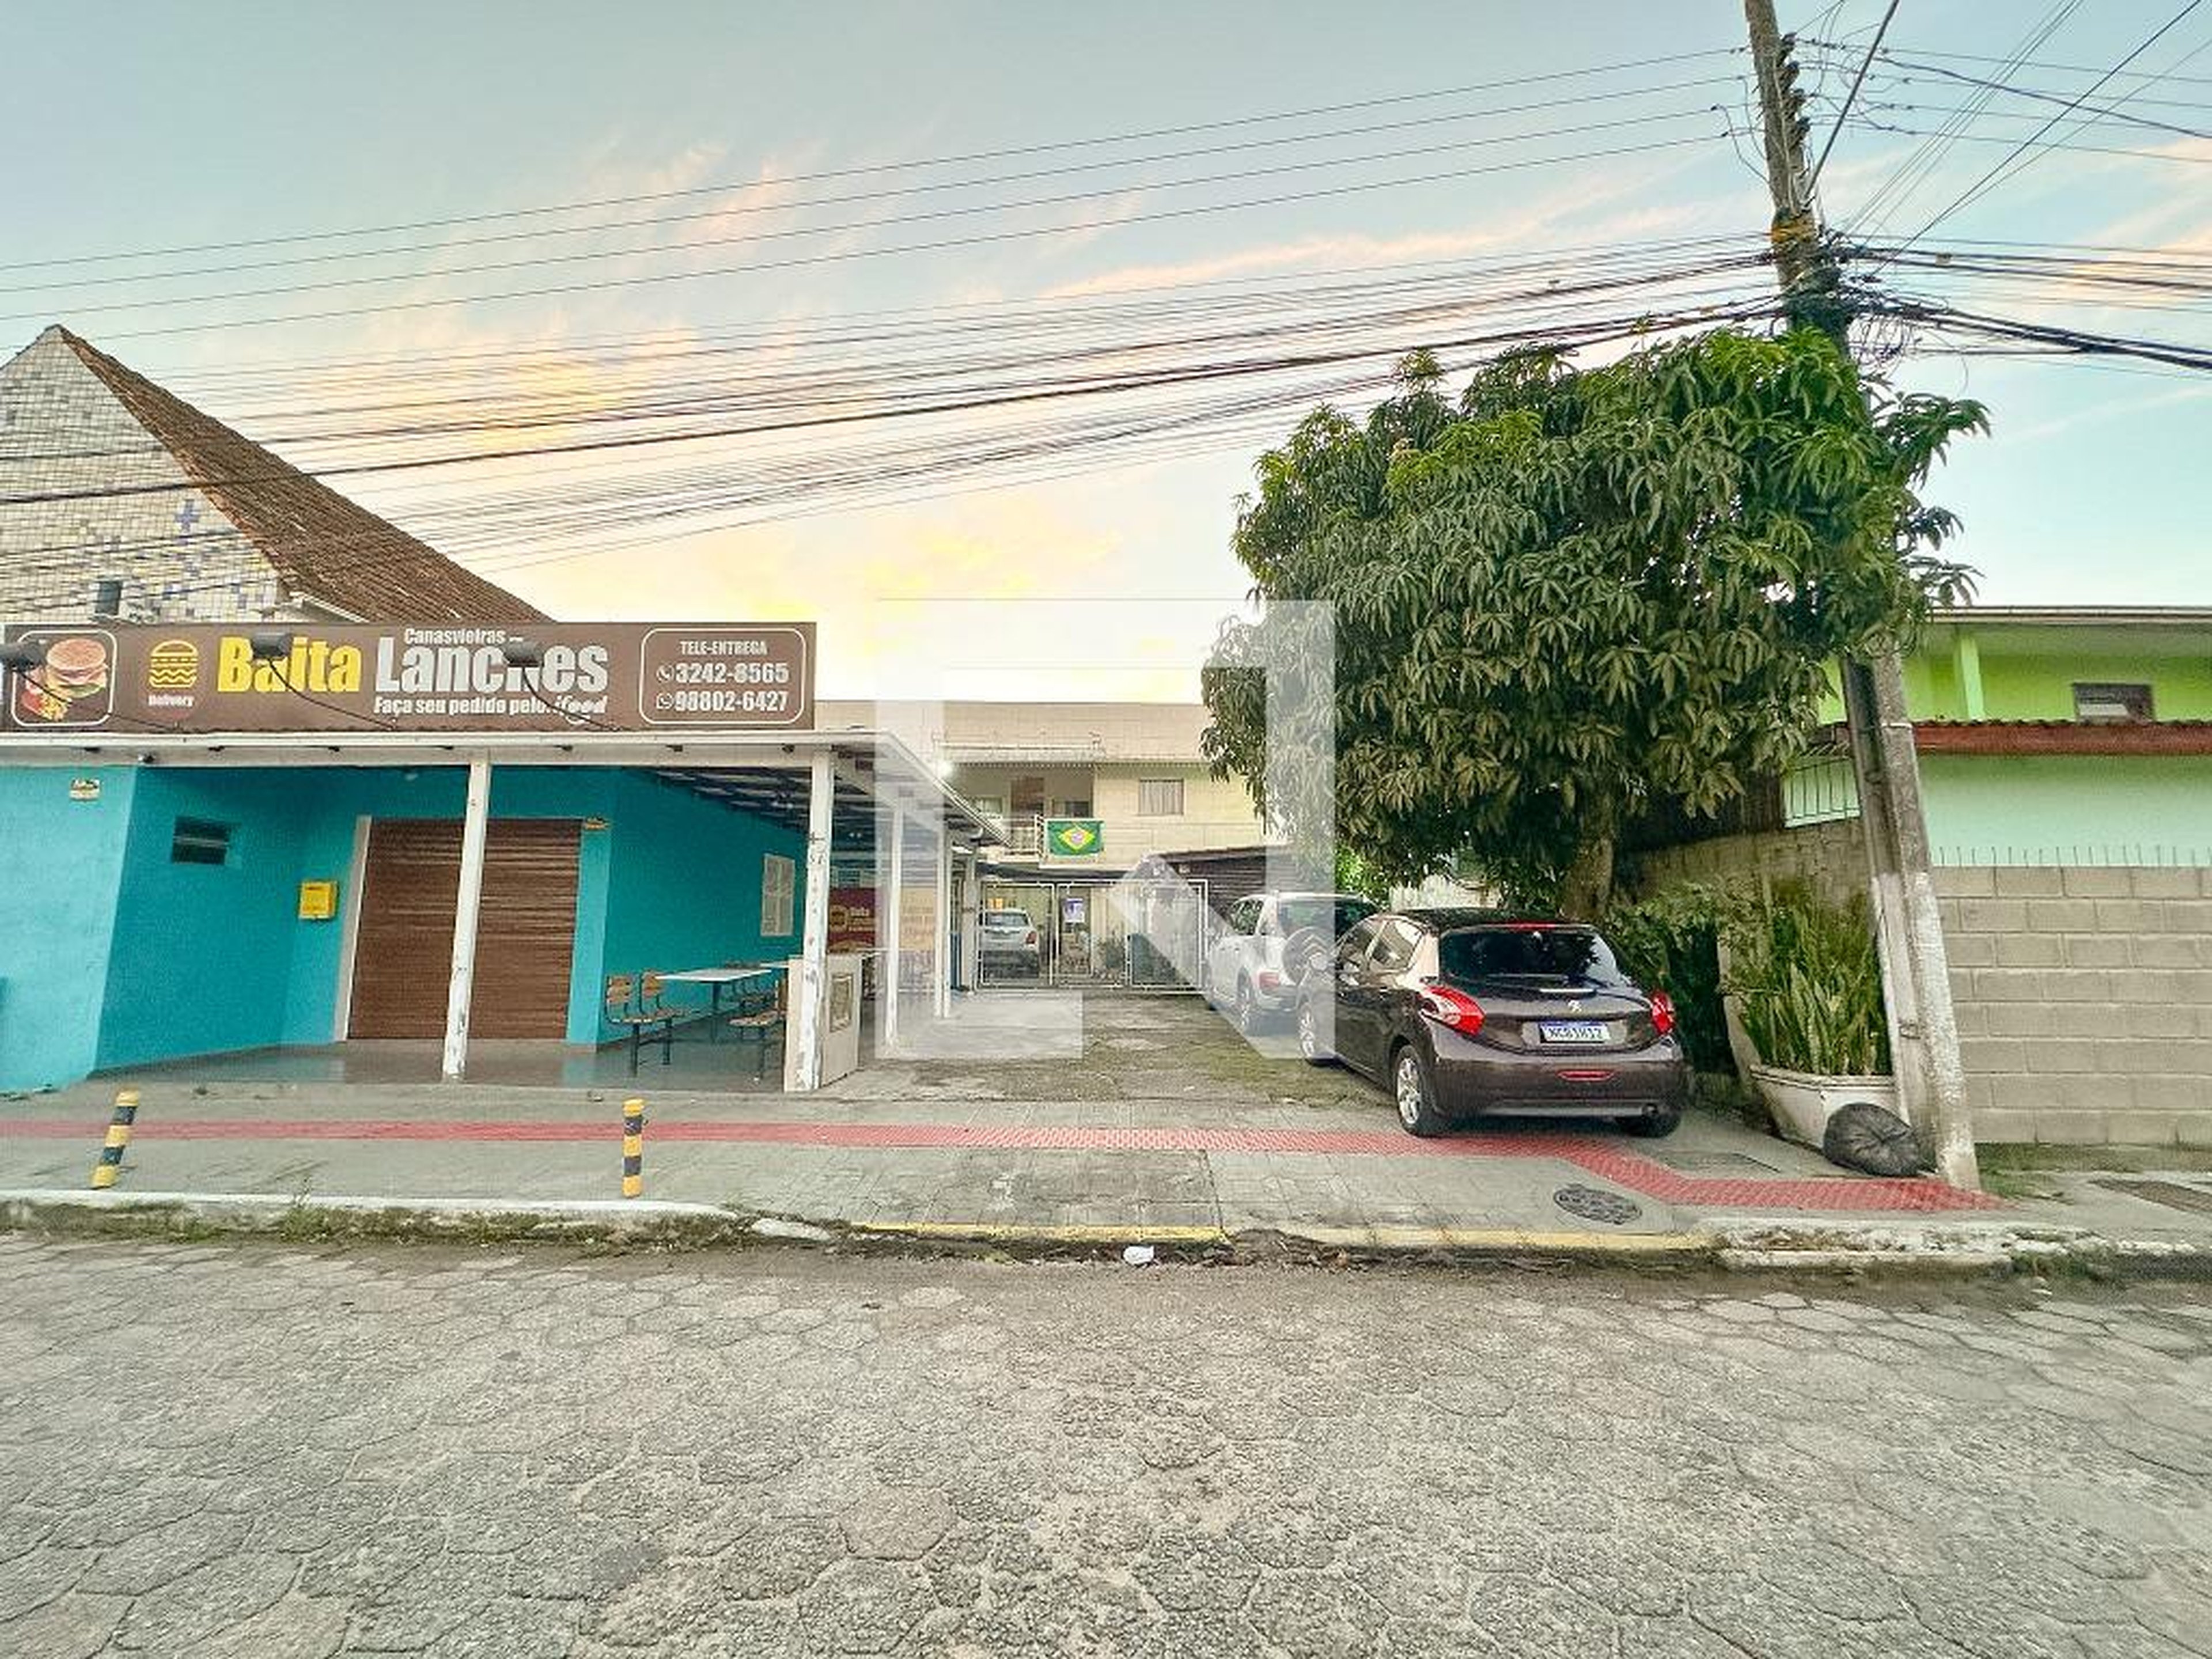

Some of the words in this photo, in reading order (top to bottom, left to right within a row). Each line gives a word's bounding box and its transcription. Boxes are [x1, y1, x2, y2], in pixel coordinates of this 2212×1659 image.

[404, 628, 506, 645] Canasvieiras
[680, 641, 767, 655] TELE-ENTREGA
[218, 637, 362, 692] Baita
[676, 662, 789, 684] 3242-8565
[374, 696, 413, 717] Faça
[415, 699, 446, 714] seu
[449, 696, 506, 716] pedido
[675, 691, 789, 712] 98802-6427
